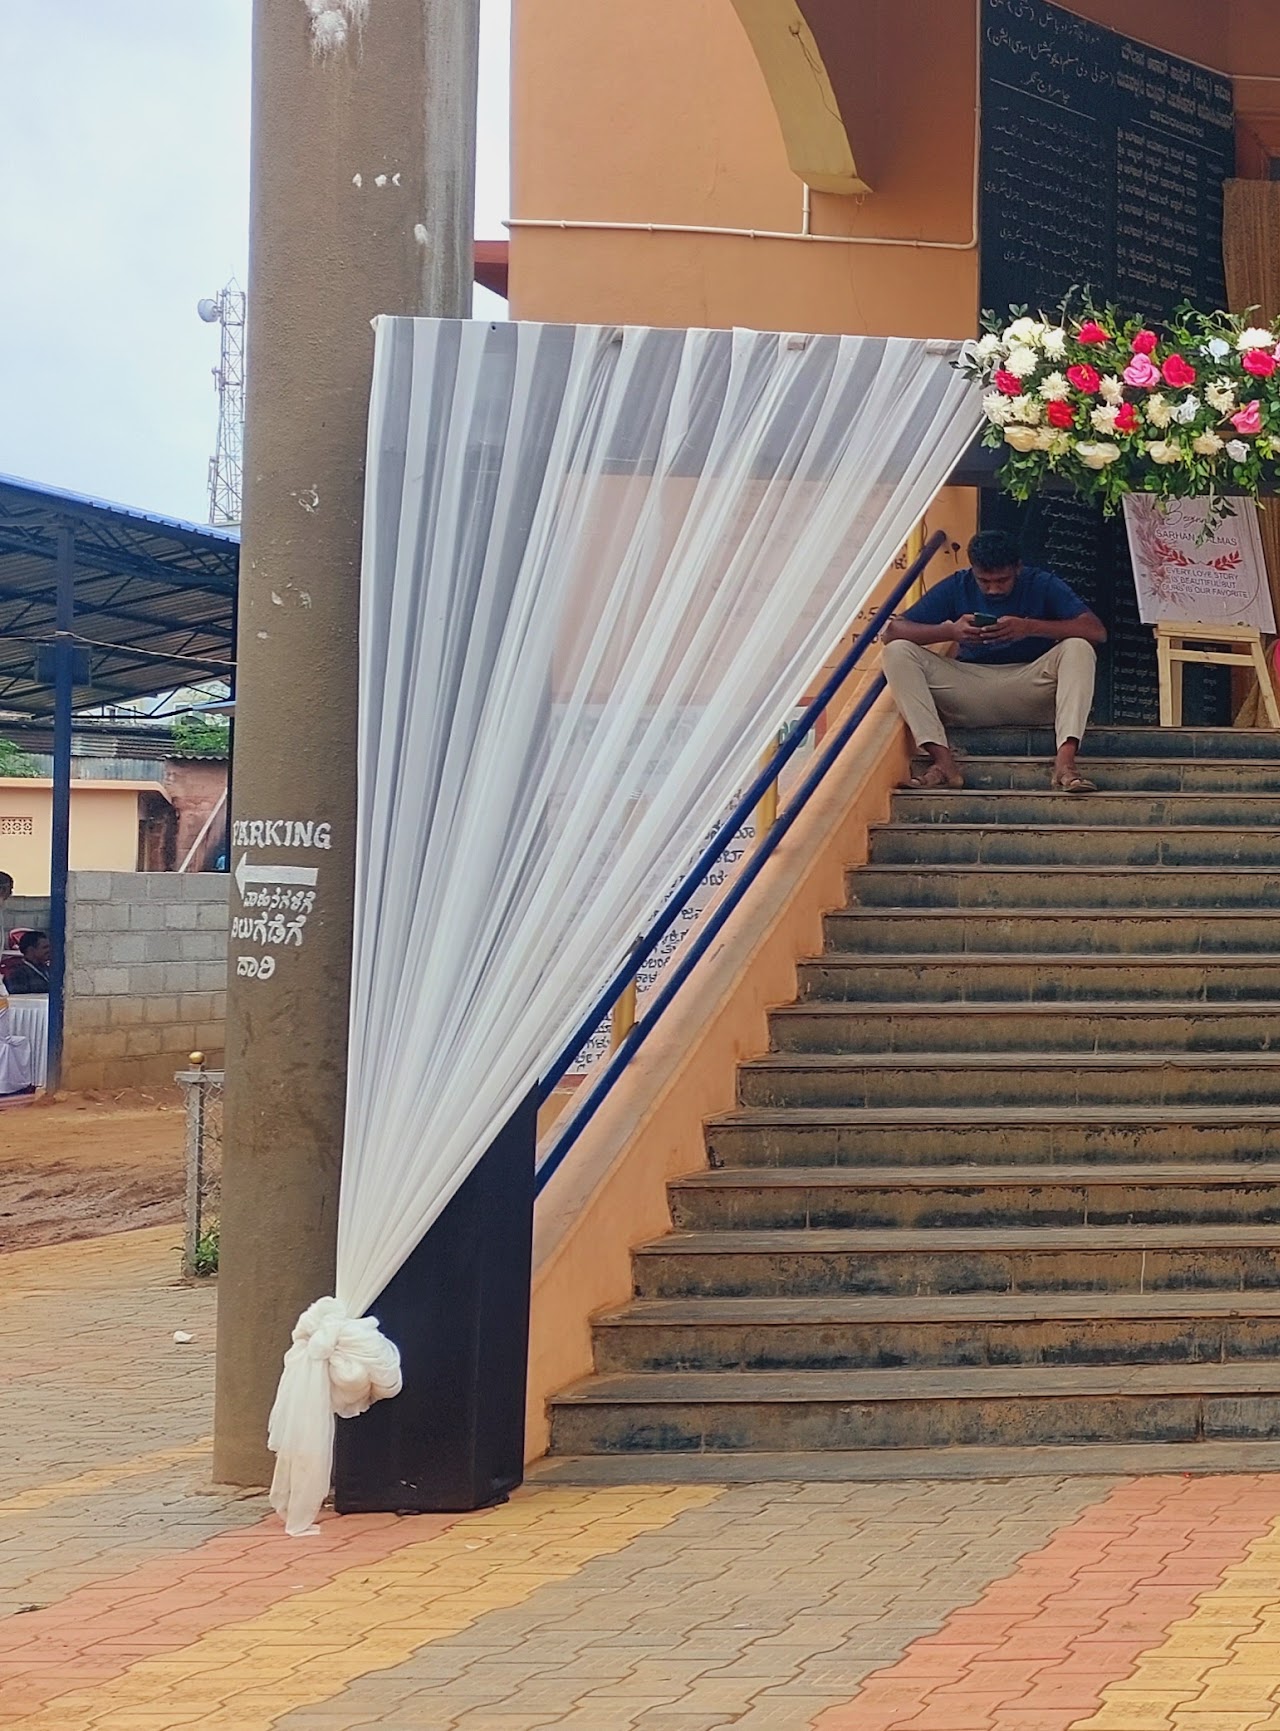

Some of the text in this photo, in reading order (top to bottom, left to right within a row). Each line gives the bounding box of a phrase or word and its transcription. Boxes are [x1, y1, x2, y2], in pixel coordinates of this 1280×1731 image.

[1155, 529, 1196, 541] SARHAN
[1166, 566, 1239, 580] EVERY LOVE STORY
[1194, 586, 1211, 594] OUR
[232, 819, 332, 850] PARKING
[236, 955, 276, 980] ದಾರಿ
